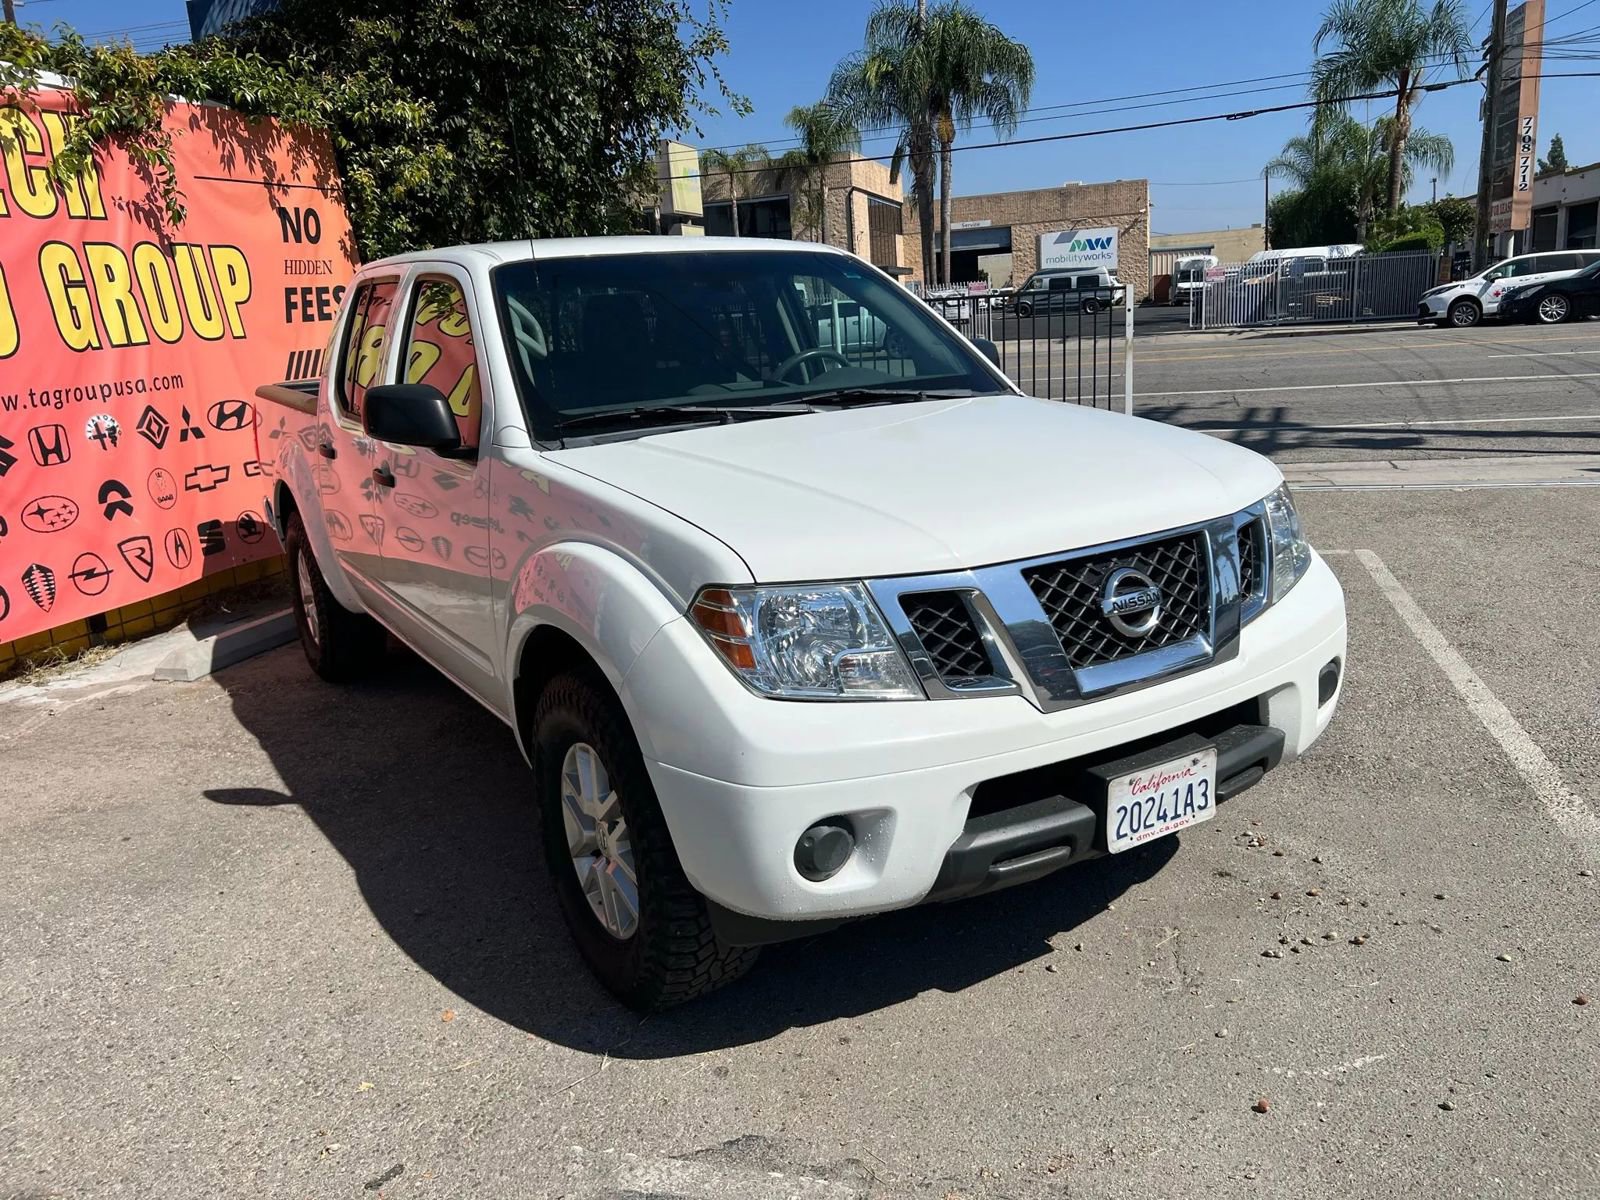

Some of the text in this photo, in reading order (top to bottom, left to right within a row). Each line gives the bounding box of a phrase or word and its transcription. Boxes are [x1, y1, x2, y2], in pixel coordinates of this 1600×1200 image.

[1521, 117, 1533, 152] 7708
[0, 106, 108, 219] CH
[1518, 157, 1530, 191] 7712
[278, 207, 322, 244] NO
[284, 259, 333, 275] HIDDEN
[1046, 251, 1112, 264] mobilityworks
[38, 240, 252, 352] GROUP
[1112, 591, 1160, 610] NISSAN
[1131, 767, 1197, 796] California
[1115, 778, 1209, 840] 20241A3
[1136, 818, 1190, 841] dmv.ca.gov
